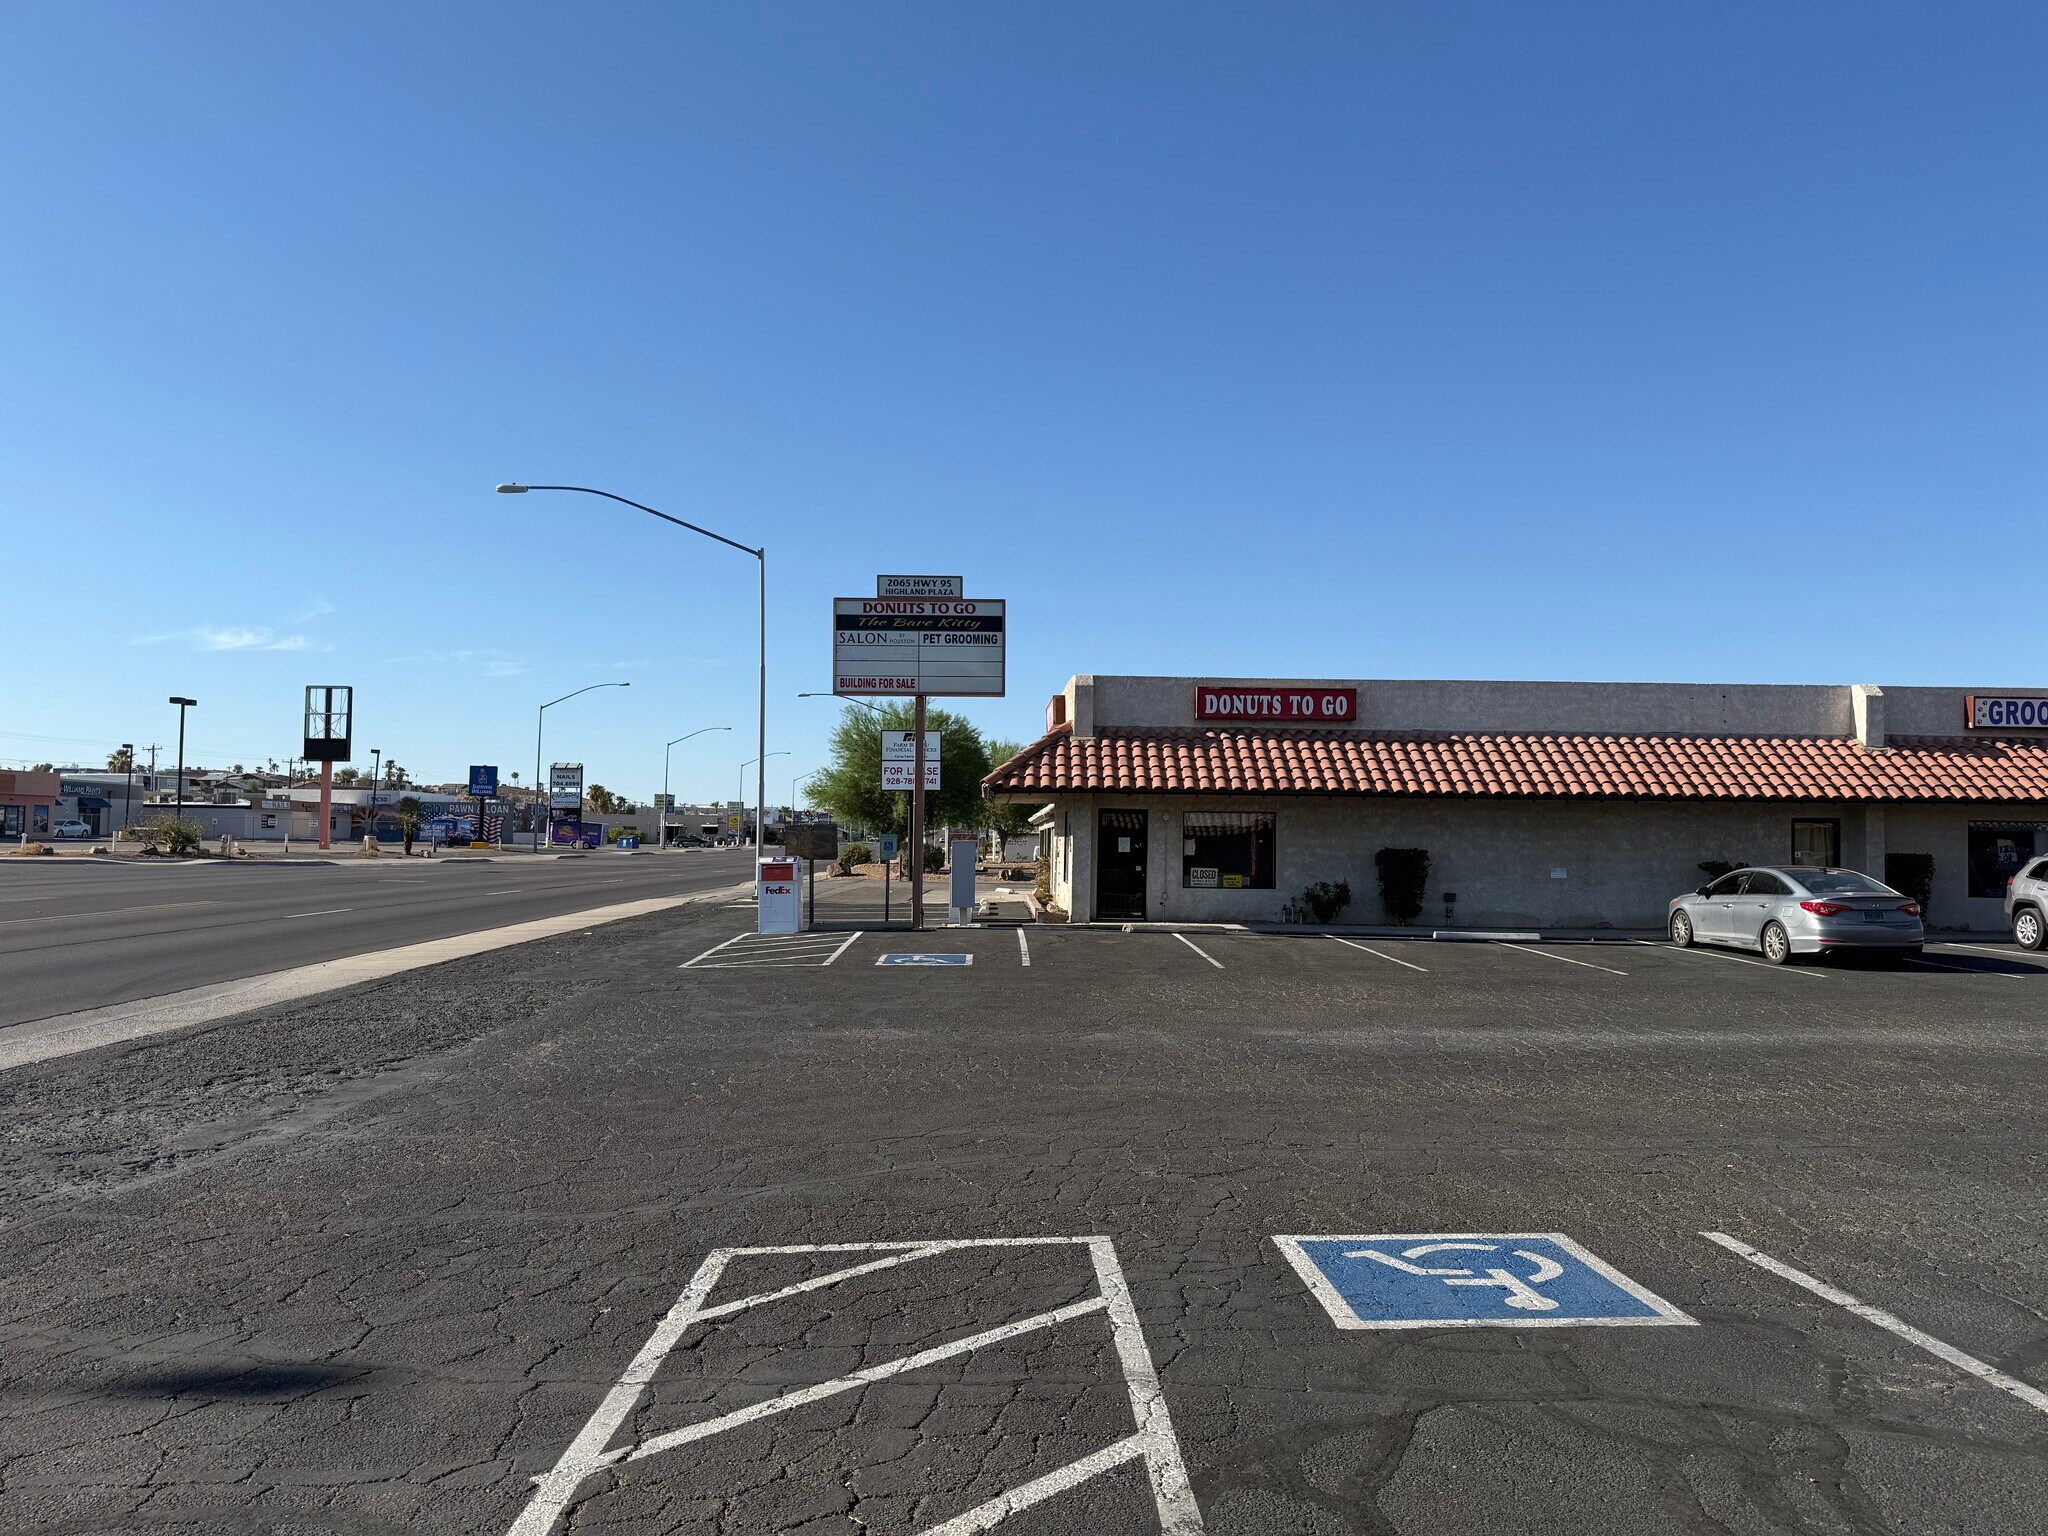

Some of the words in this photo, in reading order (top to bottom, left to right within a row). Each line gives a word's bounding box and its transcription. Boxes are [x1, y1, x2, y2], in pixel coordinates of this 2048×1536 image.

[888, 579, 910, 587] 2065
[913, 580, 937, 588] HWY
[941, 580, 952, 588] 95
[862, 602, 925, 614] DONUTS
[929, 603, 949, 614] TO
[954, 603, 977, 614] GO
[859, 617, 887, 627] The
[938, 618, 981, 630] Kitty
[839, 632, 887, 644] SALON
[923, 634, 941, 644] PET
[945, 634, 998, 645] GROOMING
[840, 678, 876, 688] BUILDING
[879, 678, 894, 688] FOR
[896, 679, 916, 689] SALE
[1204, 694, 1282, 715] DONUTS
[1289, 695, 1314, 716] TO
[1321, 696, 1348, 716] GO
[1989, 700, 2048, 726] GROO
[883, 767, 903, 775] FOR
[449, 805, 474, 814] PAWN
[486, 805, 509, 814] LOAN
[1191, 869, 1217, 880] CLOSED
[765, 885, 791, 895] FedEx
